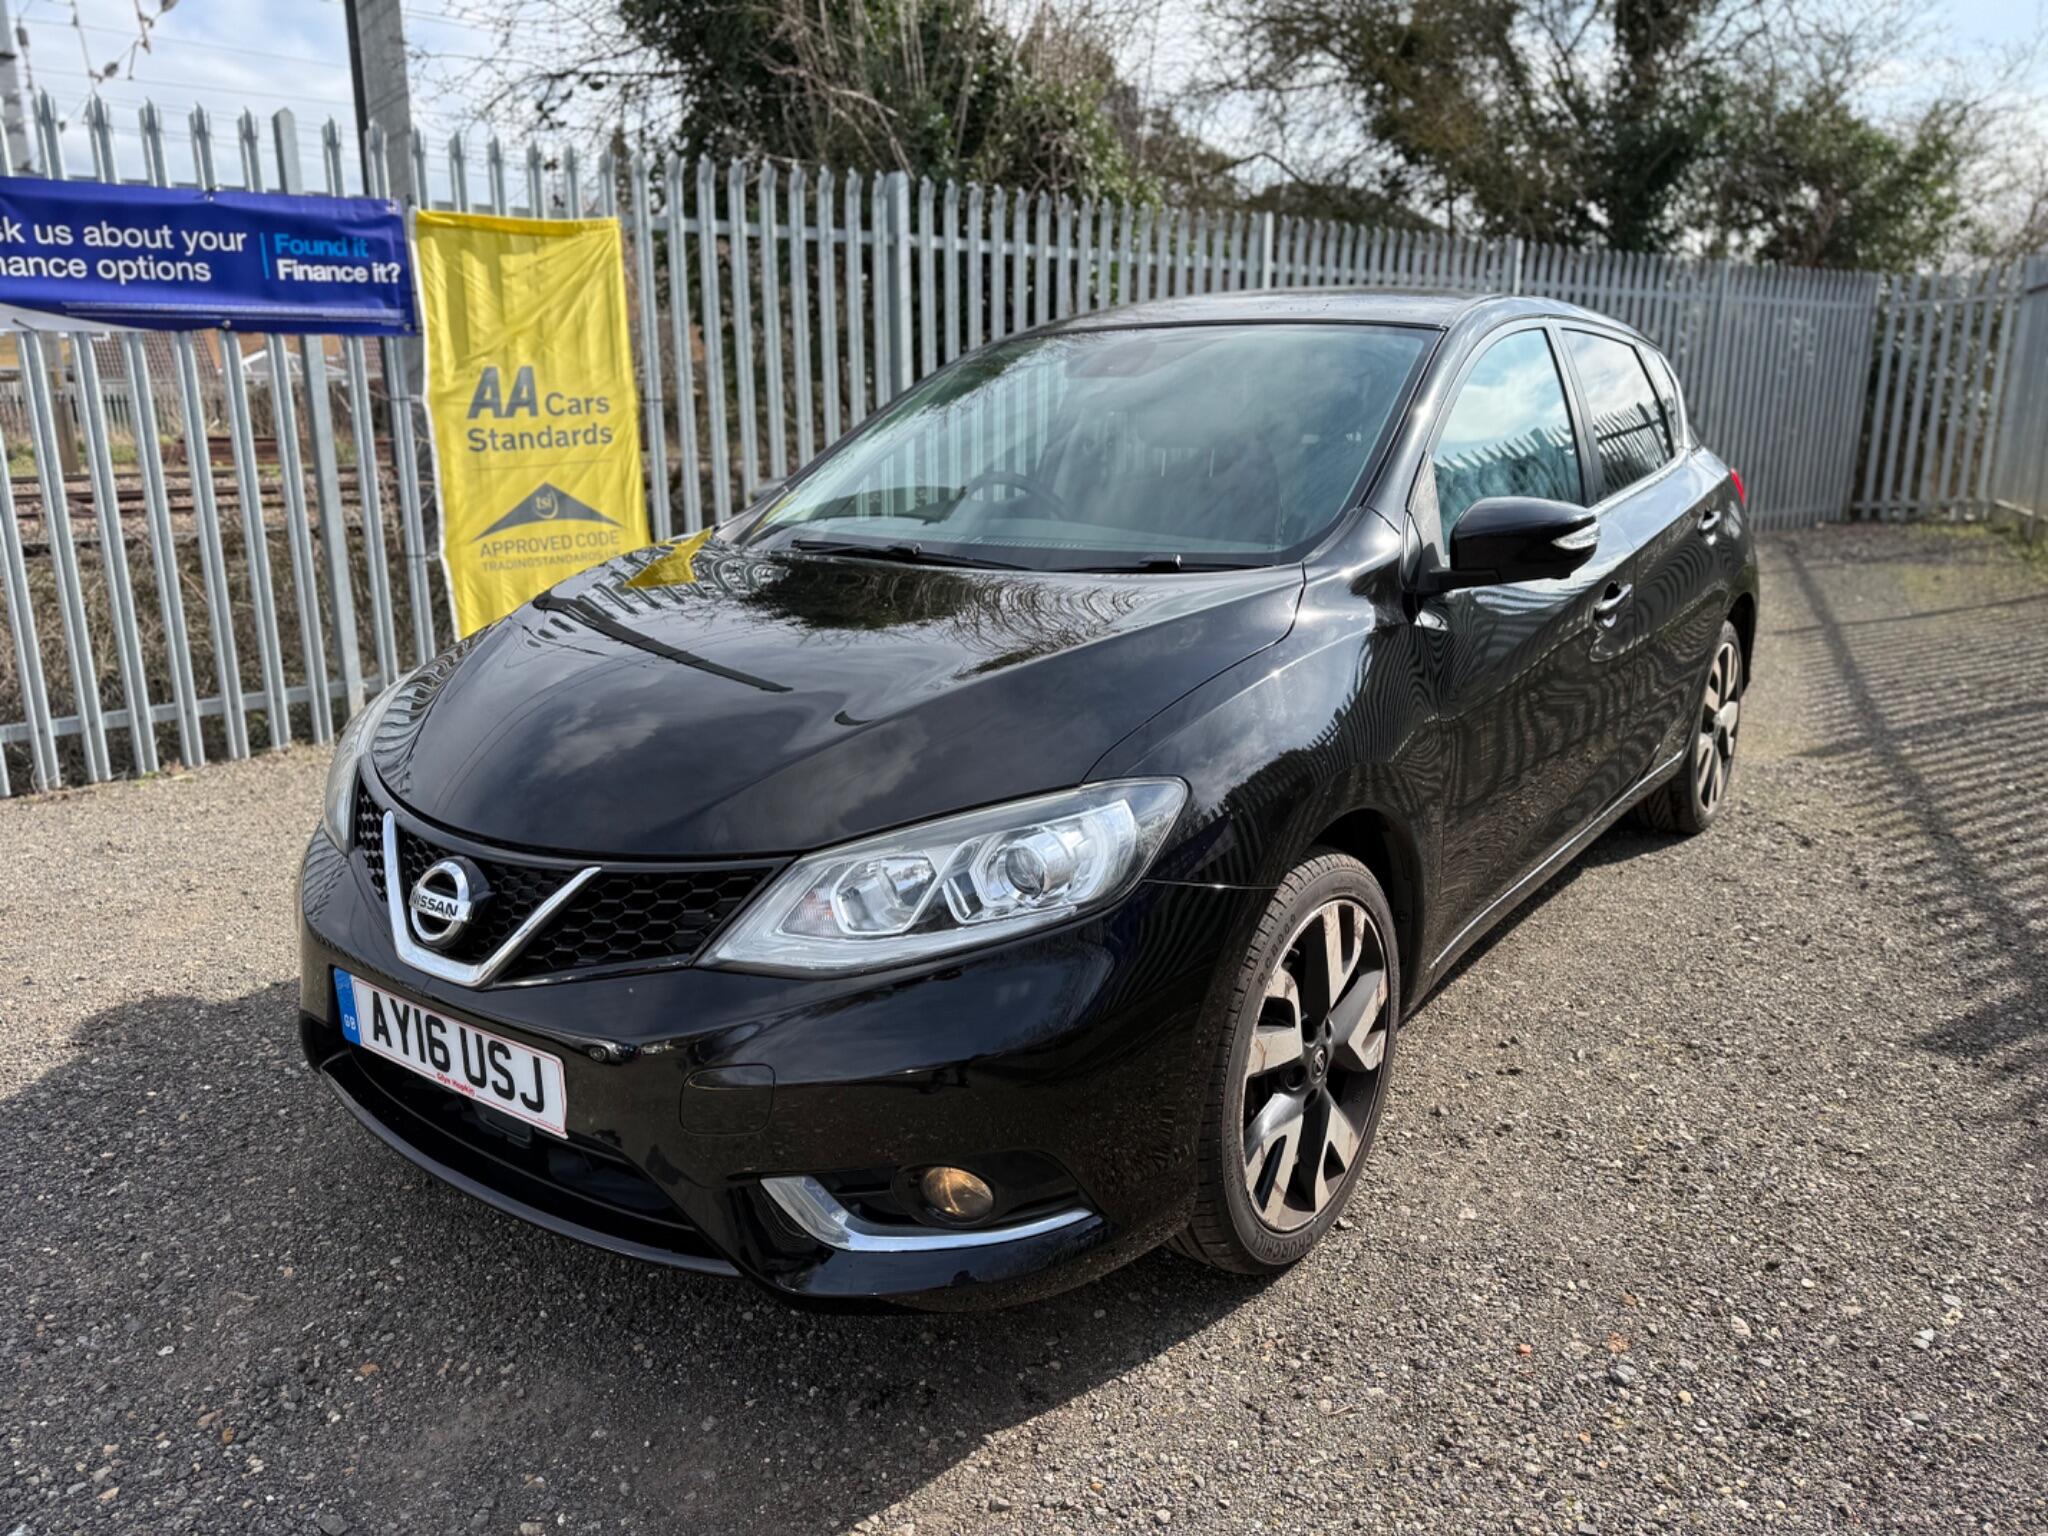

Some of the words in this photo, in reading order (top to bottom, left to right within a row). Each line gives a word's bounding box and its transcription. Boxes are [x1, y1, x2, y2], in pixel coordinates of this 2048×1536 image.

[33, 223, 74, 246] us
[83, 220, 178, 250] about
[181, 229, 247, 257] your
[274, 233, 348, 258] Found
[351, 237, 369, 259] it
[97, 256, 212, 286] options
[277, 258, 369, 283] Finance
[372, 261, 400, 284] it?
[467, 365, 539, 420] AA
[545, 392, 610, 417] Cars
[467, 422, 613, 452] Standards
[480, 534, 573, 558] APPROVED
[576, 530, 620, 548] CODE
[412, 894, 459, 918] NISSAN
[343, 1013, 357, 1031] GB
[372, 991, 451, 1073] AY16
[459, 1026, 545, 1114] USJ
